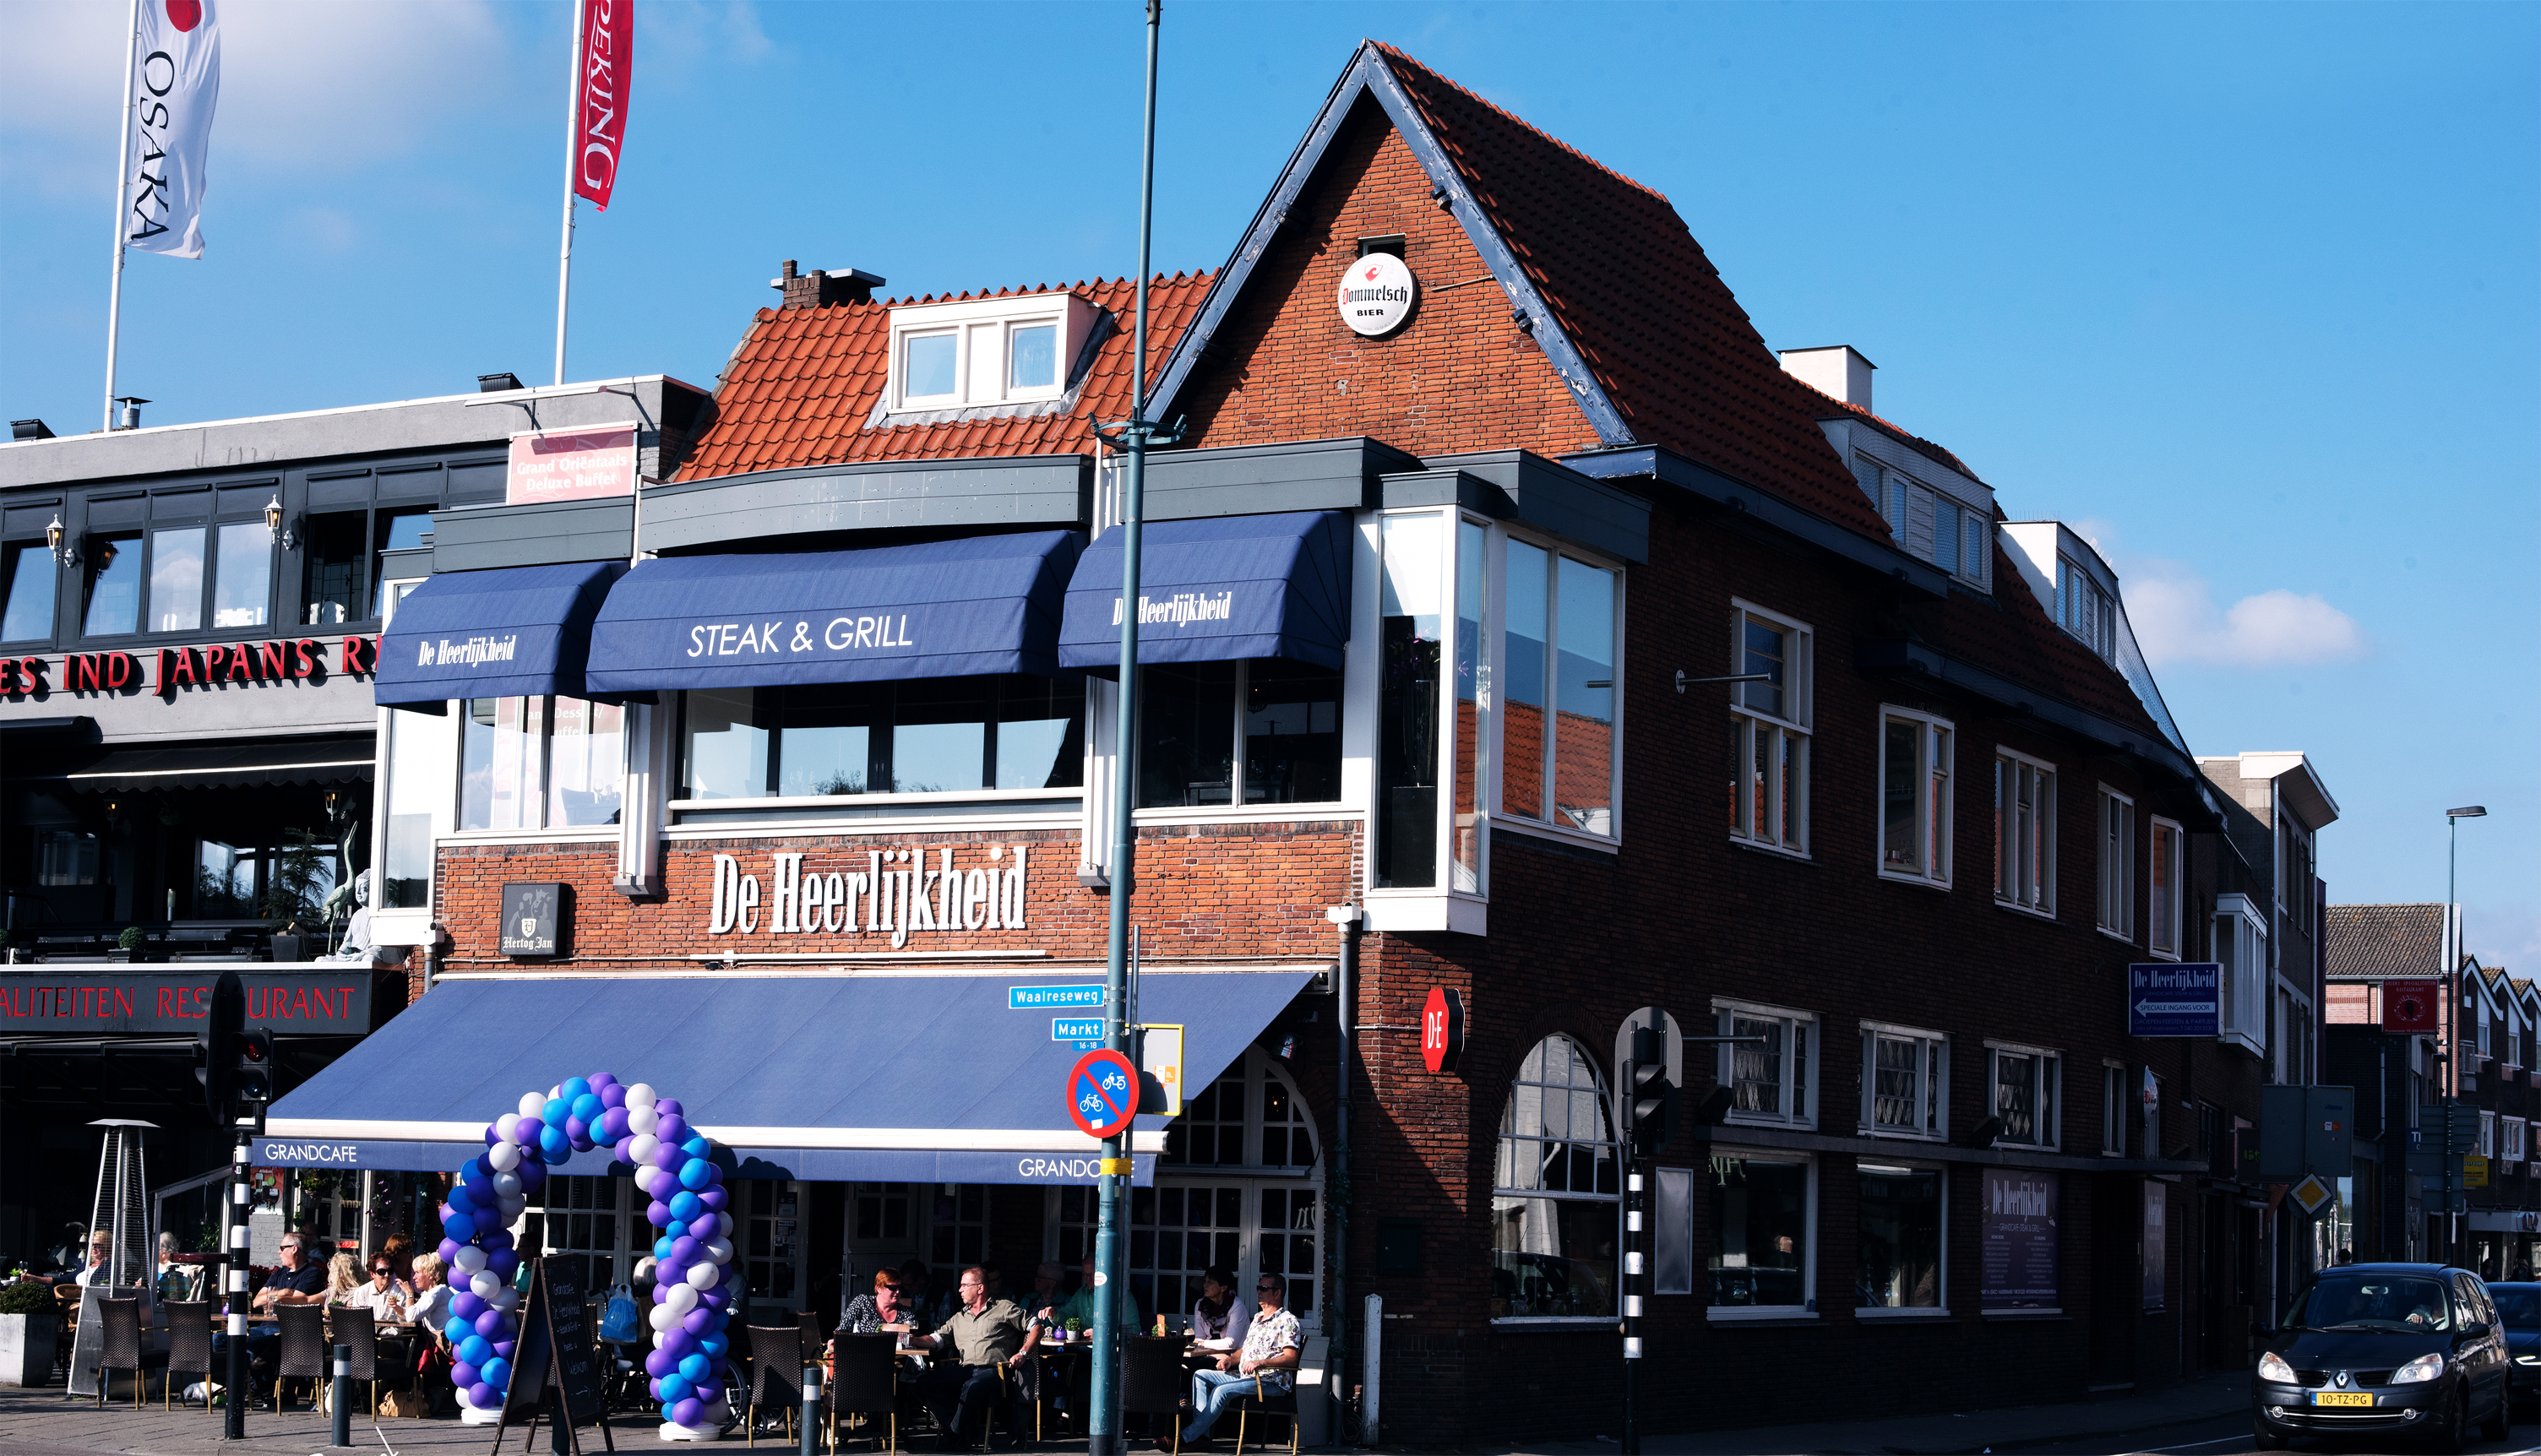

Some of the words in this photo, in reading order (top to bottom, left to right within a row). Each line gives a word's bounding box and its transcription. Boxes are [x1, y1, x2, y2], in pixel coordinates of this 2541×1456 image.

[130, 51, 175, 242] OSAKA
[1342, 285, 1408, 306] Dommelsch
[516, 459, 555, 475] Grand
[558, 453, 628, 472] Oriëntaals
[526, 477, 572, 492] Deluxe
[575, 471, 617, 487] Buffet
[1112, 598, 1124, 626] D
[687, 622, 782, 658] STEAK
[790, 625, 813, 653] &
[824, 615, 913, 651] GRILL
[417, 641, 434, 666] De
[436, 635, 516, 668] Heerlijkheid
[63, 651, 130, 691] IND
[152, 638, 314, 697] JAPANS
[708, 853, 759, 934] De
[770, 846, 1026, 949] Heerlijkheid
[502, 936, 535, 952] Hertog
[535, 936, 553, 952] Jan
[2135, 970, 2147, 988] De
[2151, 970, 2216, 991] Heerlijkheid
[0, 986, 133, 1018] ALITEITEN
[156, 986, 355, 1019] RESURANT
[1016, 990, 1098, 1004] Waalreseweg
[1058, 1023, 1099, 1035] Markt
[1079, 1041, 1097, 1050] 16-18
[265, 1144, 357, 1162] GRANDCAFE
[1018, 1158, 1135, 1178] GRANDC
[1993, 1179, 2002, 1214] De
[2004, 1180, 2047, 1224] Heerlijkheid
[2321, 1394, 2367, 1404] 10-TZ-PG
